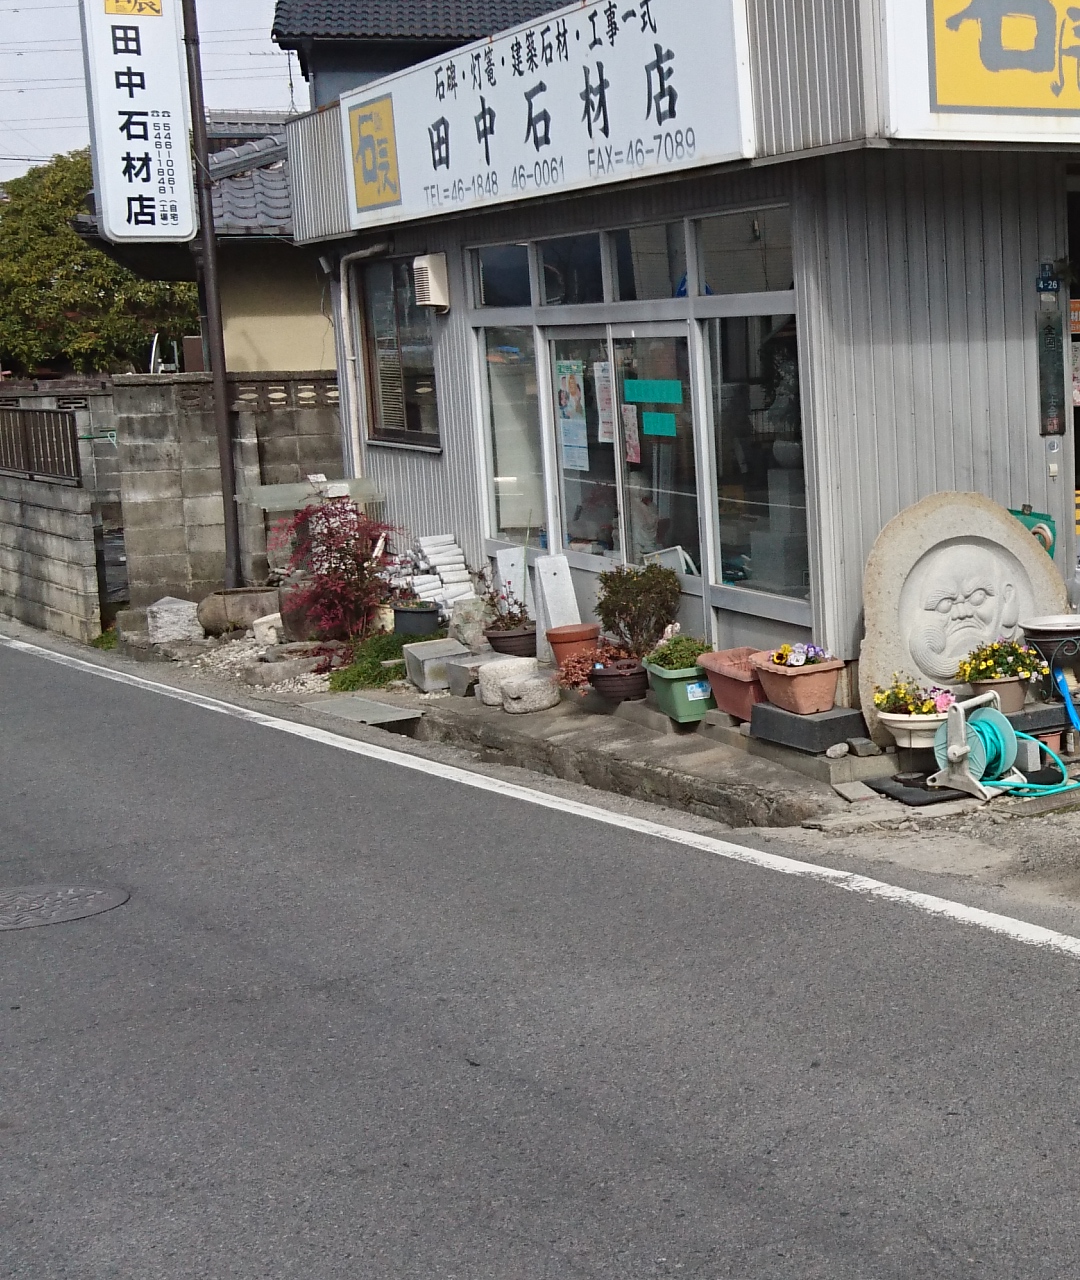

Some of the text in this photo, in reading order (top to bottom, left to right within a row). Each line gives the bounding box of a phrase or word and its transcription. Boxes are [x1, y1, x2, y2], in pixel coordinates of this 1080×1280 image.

[111, 24, 156, 226] 田中石材店
[428, 43, 678, 170] 田中石材店
[511, 156, 565, 191] 46-0061
[1039, 280, 1058, 289] 4-26
